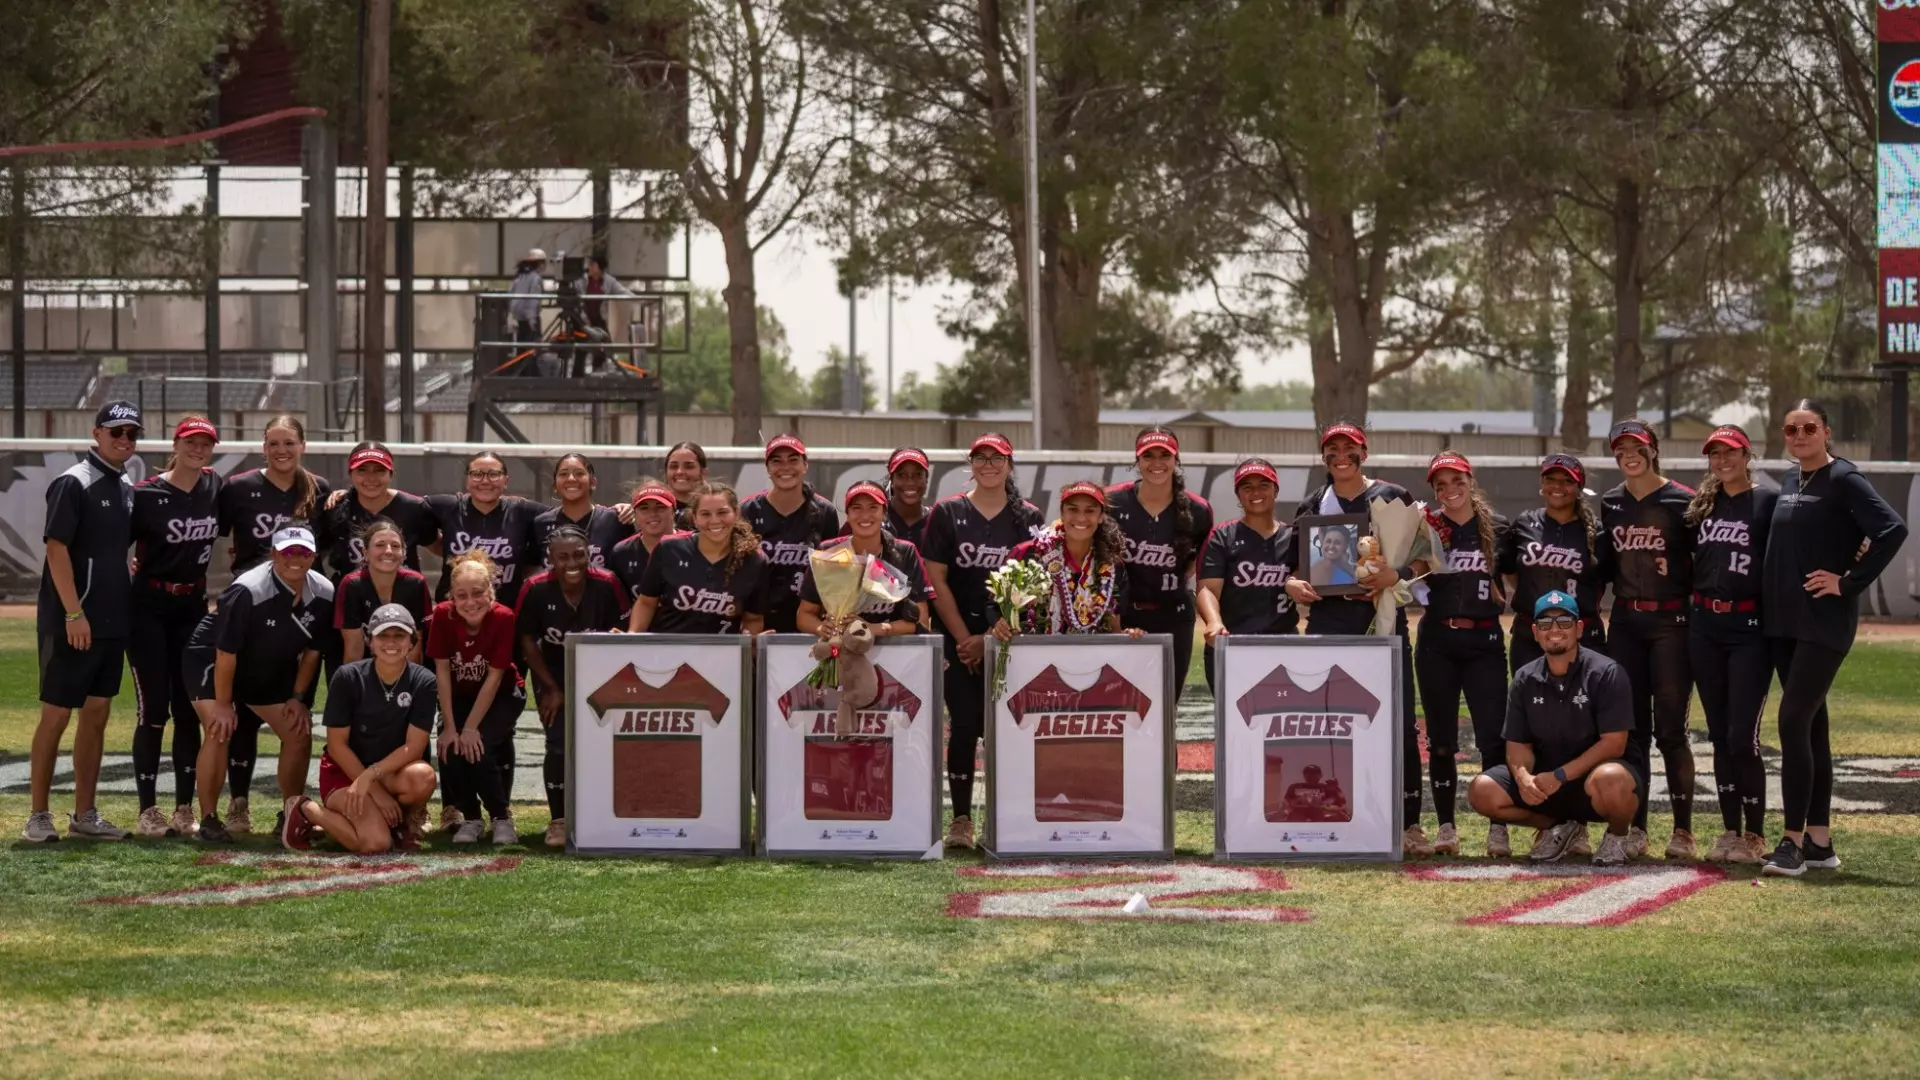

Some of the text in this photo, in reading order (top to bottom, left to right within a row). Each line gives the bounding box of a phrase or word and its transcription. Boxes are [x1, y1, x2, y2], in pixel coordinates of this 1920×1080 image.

[368, 451, 384, 459] STATE
[1612, 524, 1666, 552] State
[1697, 518, 1751, 547] State
[956, 541, 1010, 568] Stat
[1448, 547, 1489, 573] tate
[1522, 541, 1584, 575] State
[1653, 556, 1668, 576] 3
[1728, 551, 1751, 576] 12
[1161, 573, 1179, 591] 11
[1478, 579, 1490, 600] 5
[1566, 579, 1578, 599] 8
[673, 584, 736, 615] State
[718, 619, 733, 634] 7
[619, 711, 696, 733] AGGIES
[1034, 713, 1126, 737] AGGIES
[1265, 714, 1354, 738] AGGIES
